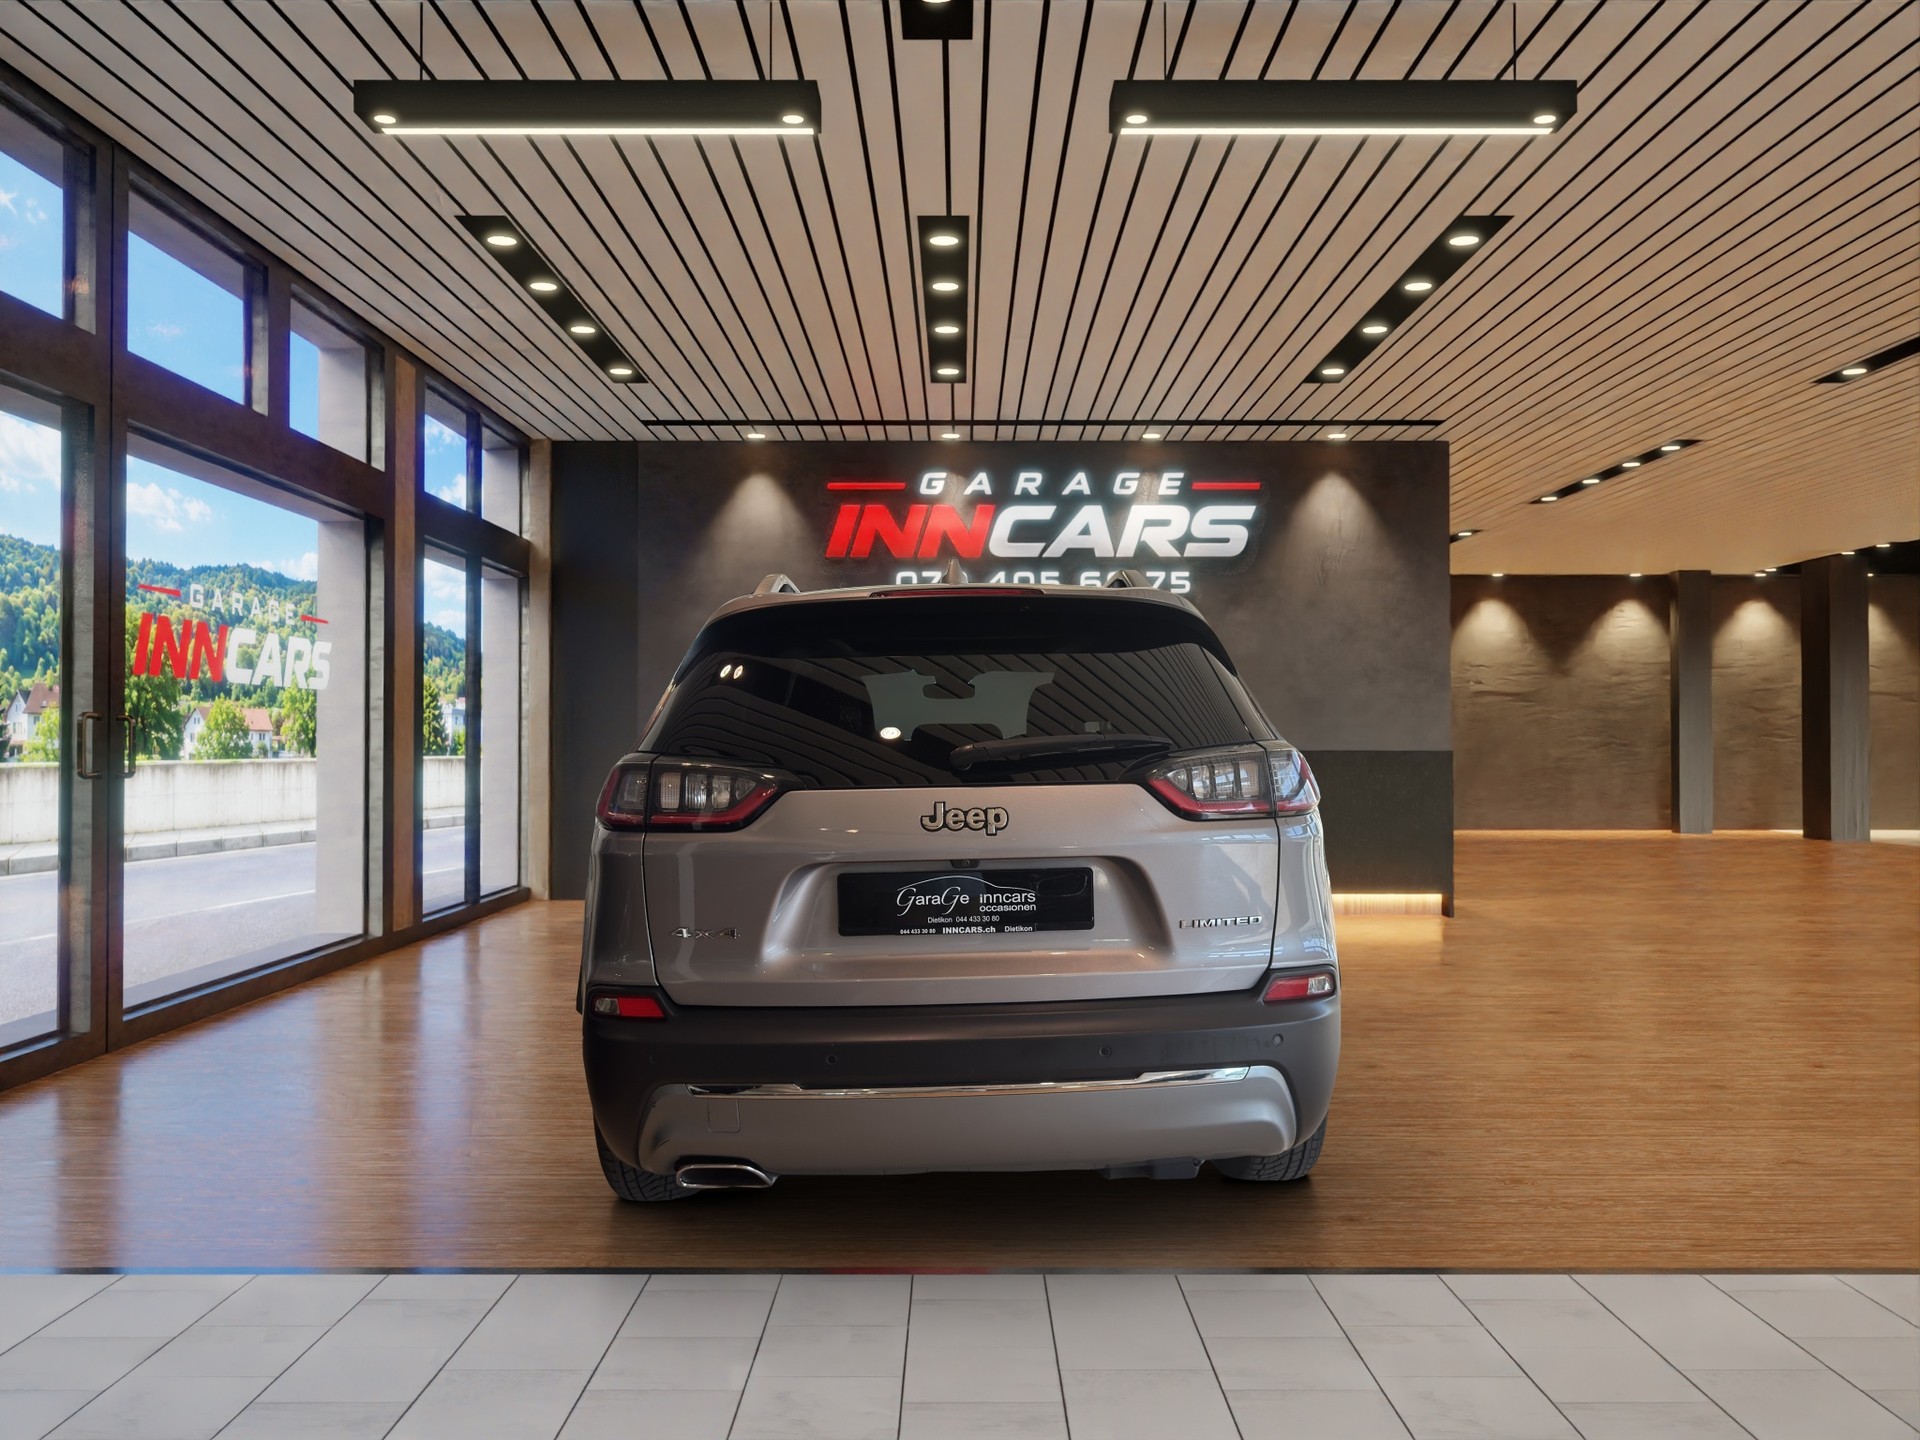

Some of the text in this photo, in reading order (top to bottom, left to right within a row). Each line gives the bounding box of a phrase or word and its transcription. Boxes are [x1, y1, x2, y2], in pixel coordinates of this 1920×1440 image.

[919, 472, 1186, 496] GARAGE
[825, 504, 1257, 558] INNCARS
[896, 571, 969, 584] 07
[1146, 571, 1191, 594] 75
[189, 583, 296, 626] GARAGE
[132, 612, 333, 690] INNCARS
[920, 801, 1009, 836] Jeep
[979, 892, 1036, 904] inncars
[979, 904, 1037, 913] occasionen
[927, 916, 953, 924] Dietikon
[942, 926, 997, 934] INNCARS.ch
[1179, 915, 1263, 929] LIMITED
